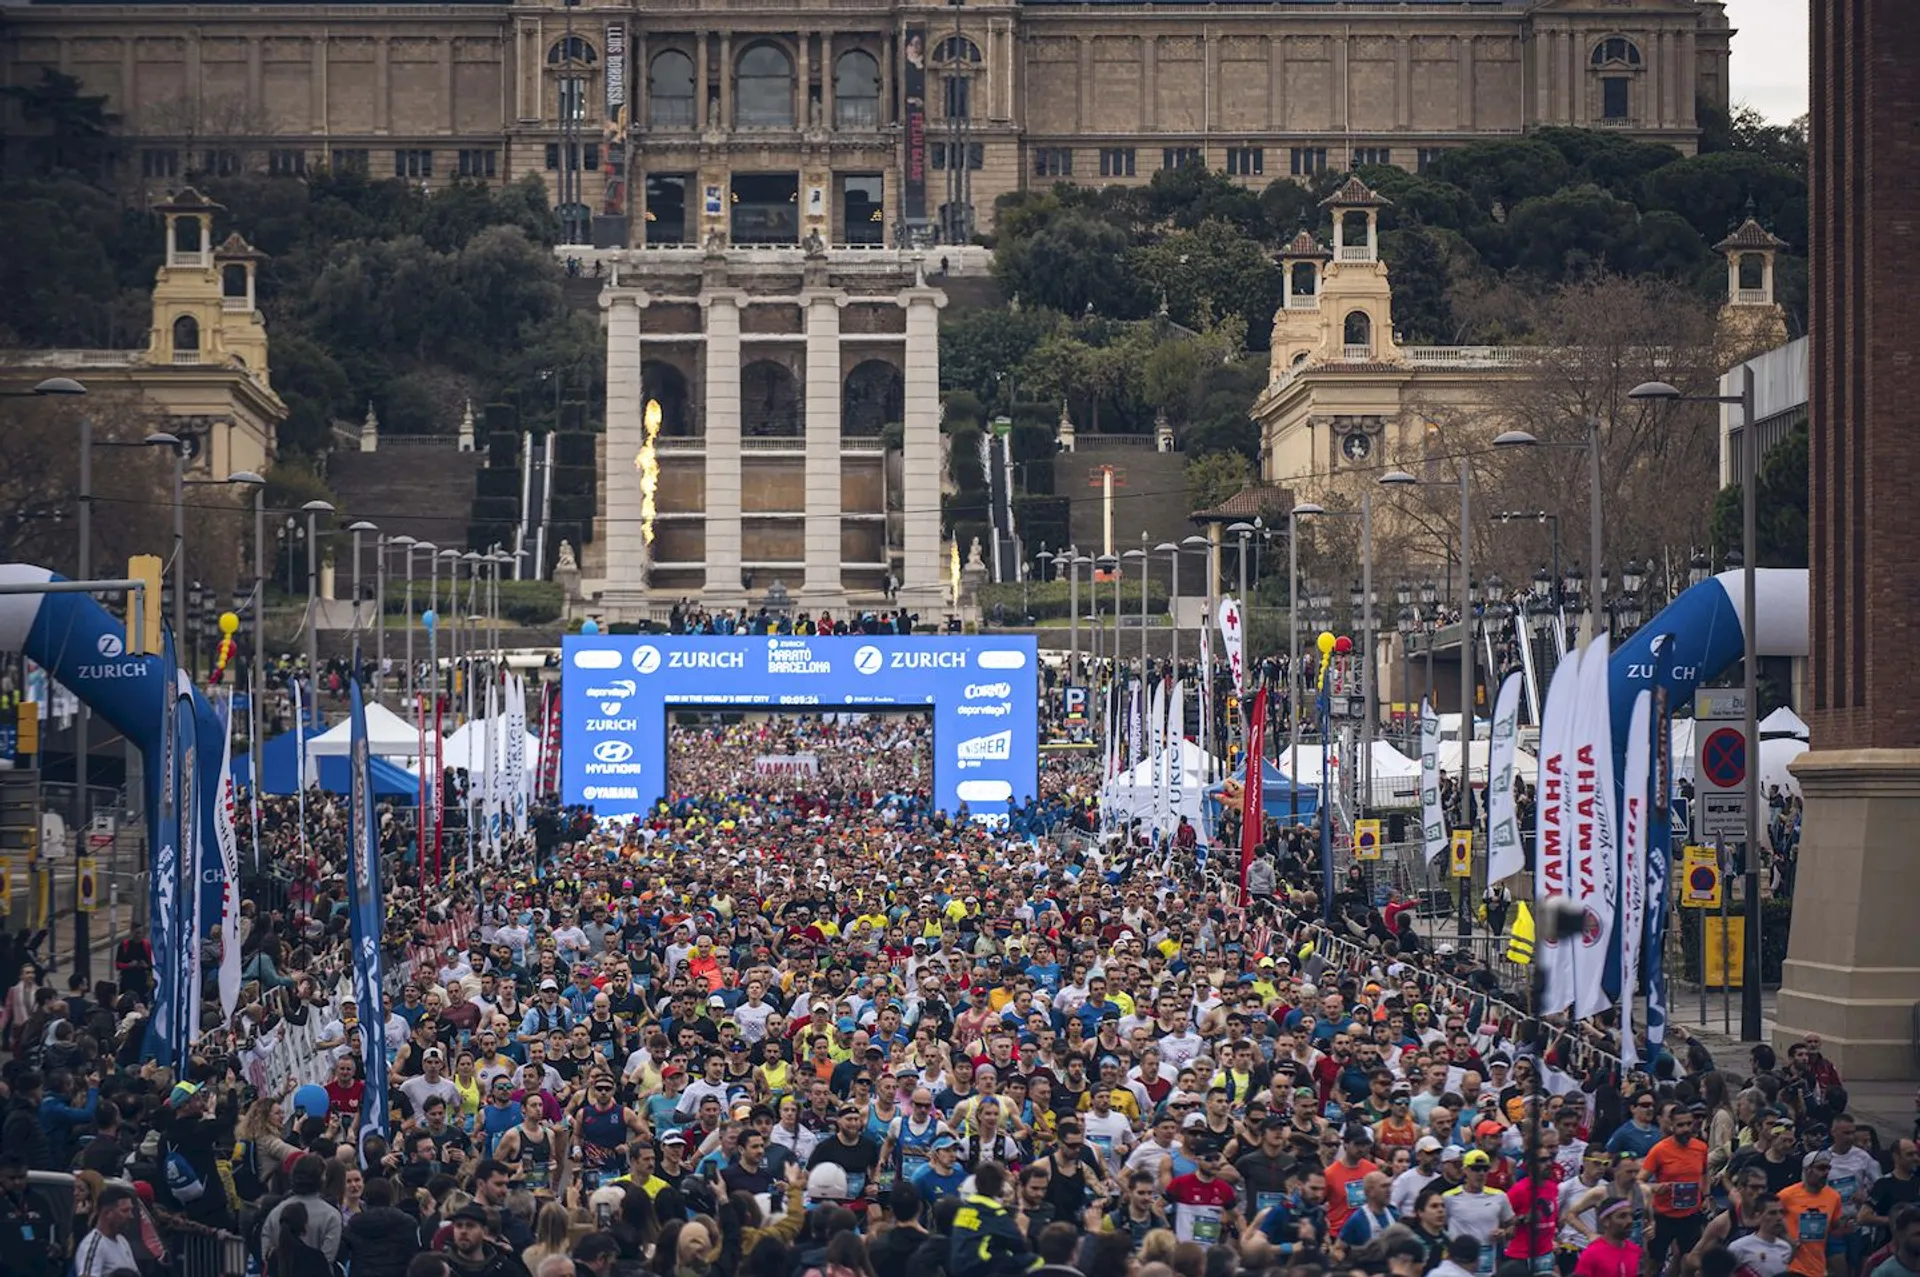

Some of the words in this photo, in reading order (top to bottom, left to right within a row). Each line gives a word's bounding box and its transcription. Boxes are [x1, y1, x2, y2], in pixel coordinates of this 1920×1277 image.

[668, 651, 744, 668] ZURICH
[768, 661, 831, 673] BARCELONA
[890, 651, 966, 668] ZURICH
[78, 663, 147, 679] ZURICH
[1627, 664, 1696, 680] ZUCH
[586, 719, 637, 731] ZURICH
[959, 738, 1006, 755] NISHER
[585, 763, 641, 774] HYUNDAI
[596, 786, 639, 799] YAMAHA
[1544, 754, 1563, 901] YAMAHA
[1577, 744, 1595, 900] YAMAHA
[1596, 808, 1613, 850] Your
[1601, 851, 1616, 913] Revs
